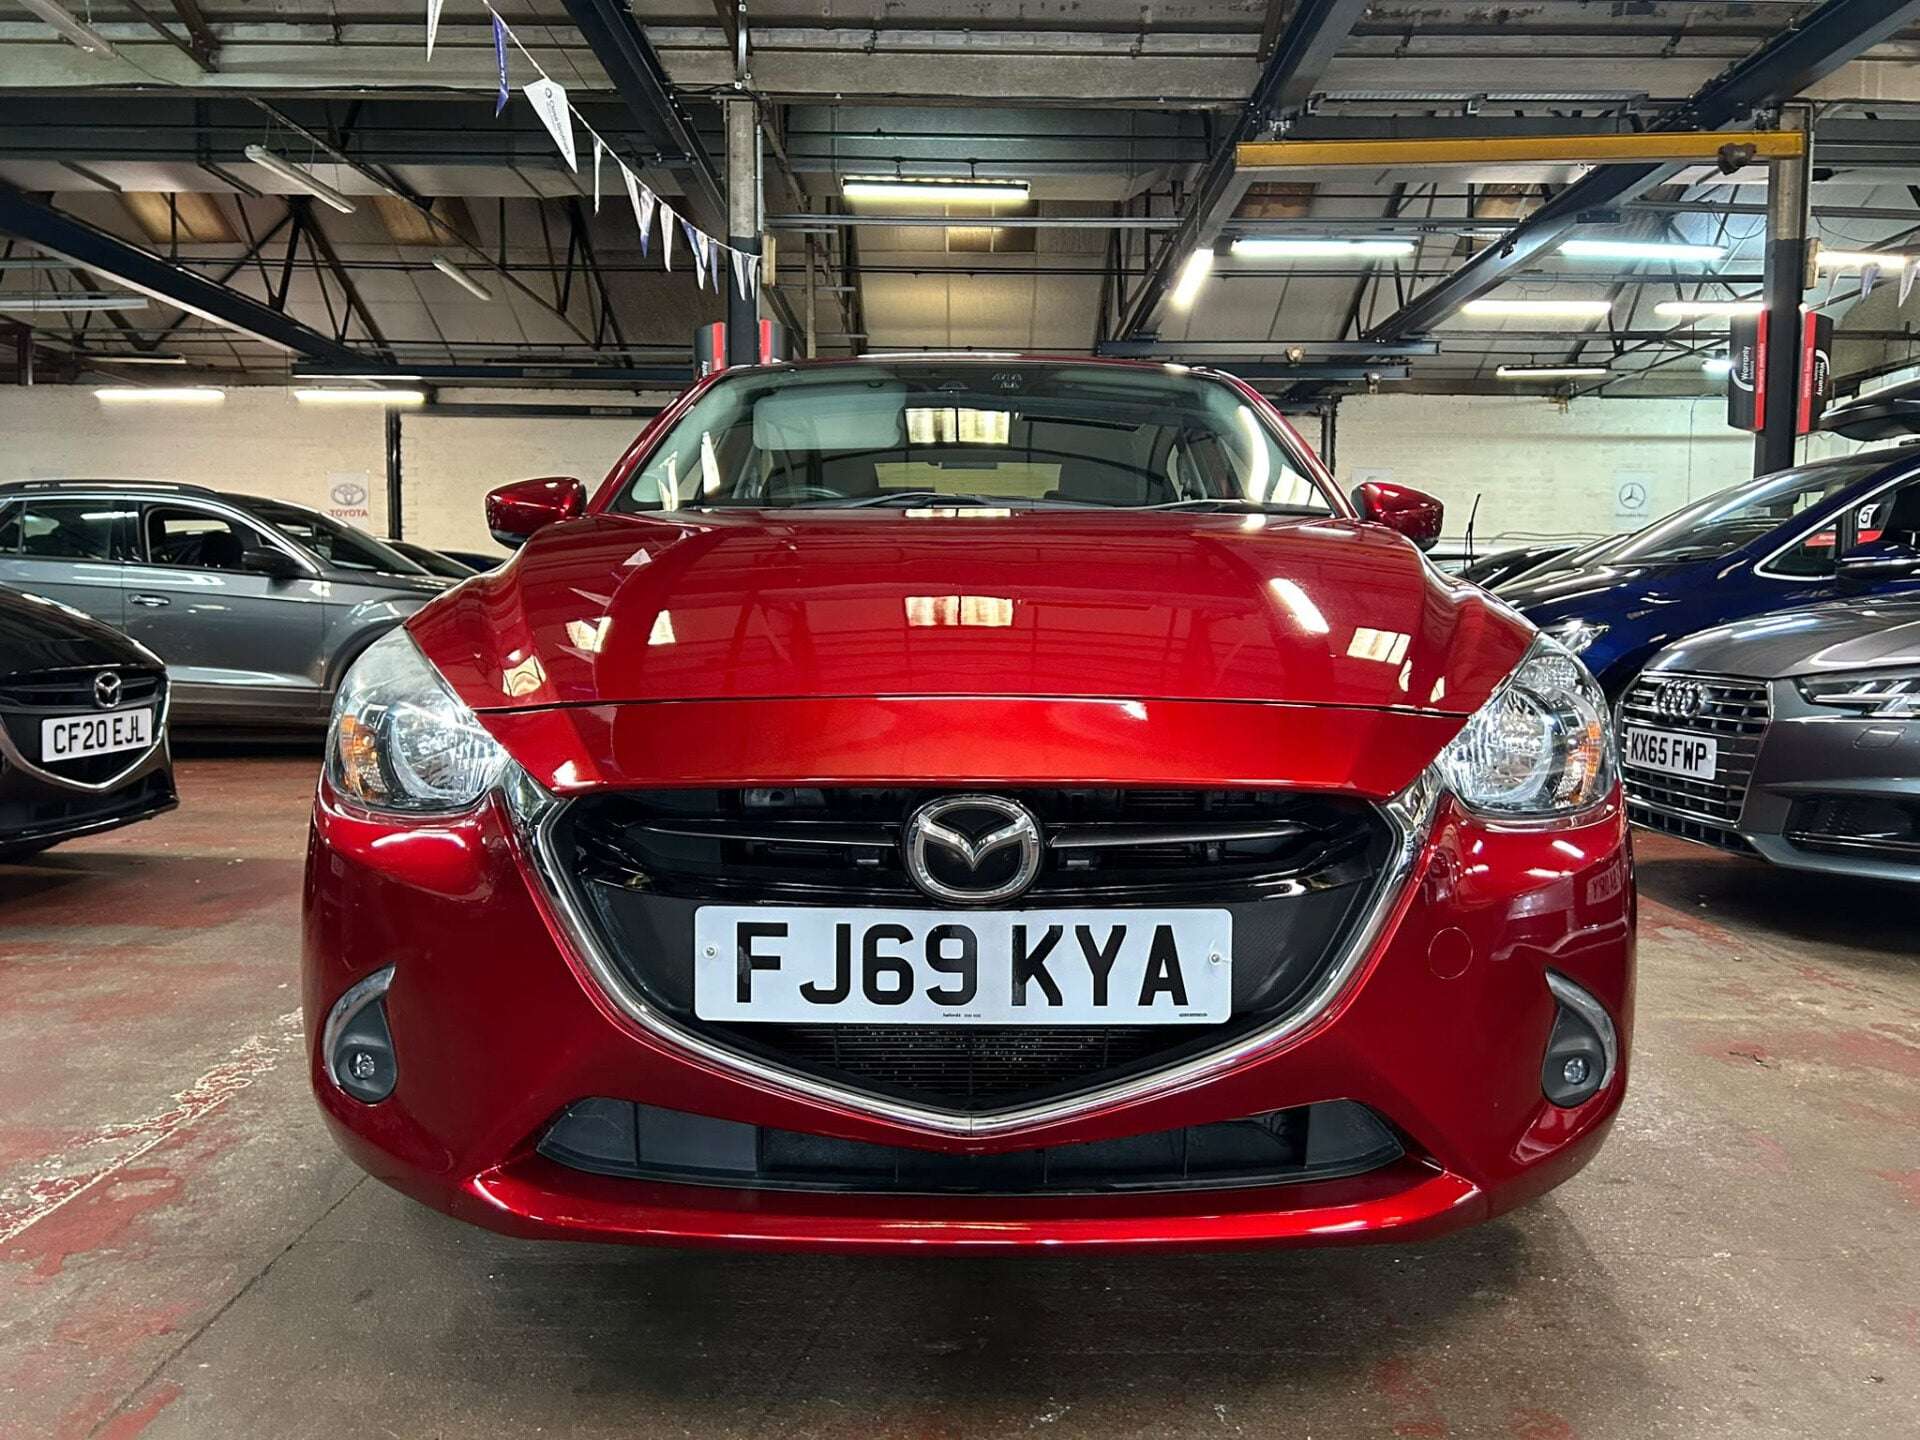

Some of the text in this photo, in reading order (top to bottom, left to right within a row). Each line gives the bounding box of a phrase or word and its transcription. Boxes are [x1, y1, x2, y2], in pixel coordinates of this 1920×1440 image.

[1741, 346, 1751, 380] Warranty
[1816, 362, 1825, 396] Warranty
[330, 509, 368, 517] TOYOTA
[54, 715, 144, 754] CF20 EJL
[1631, 732, 1707, 771] KX65 FWP
[737, 922, 1189, 1006] FJ69 KYA
